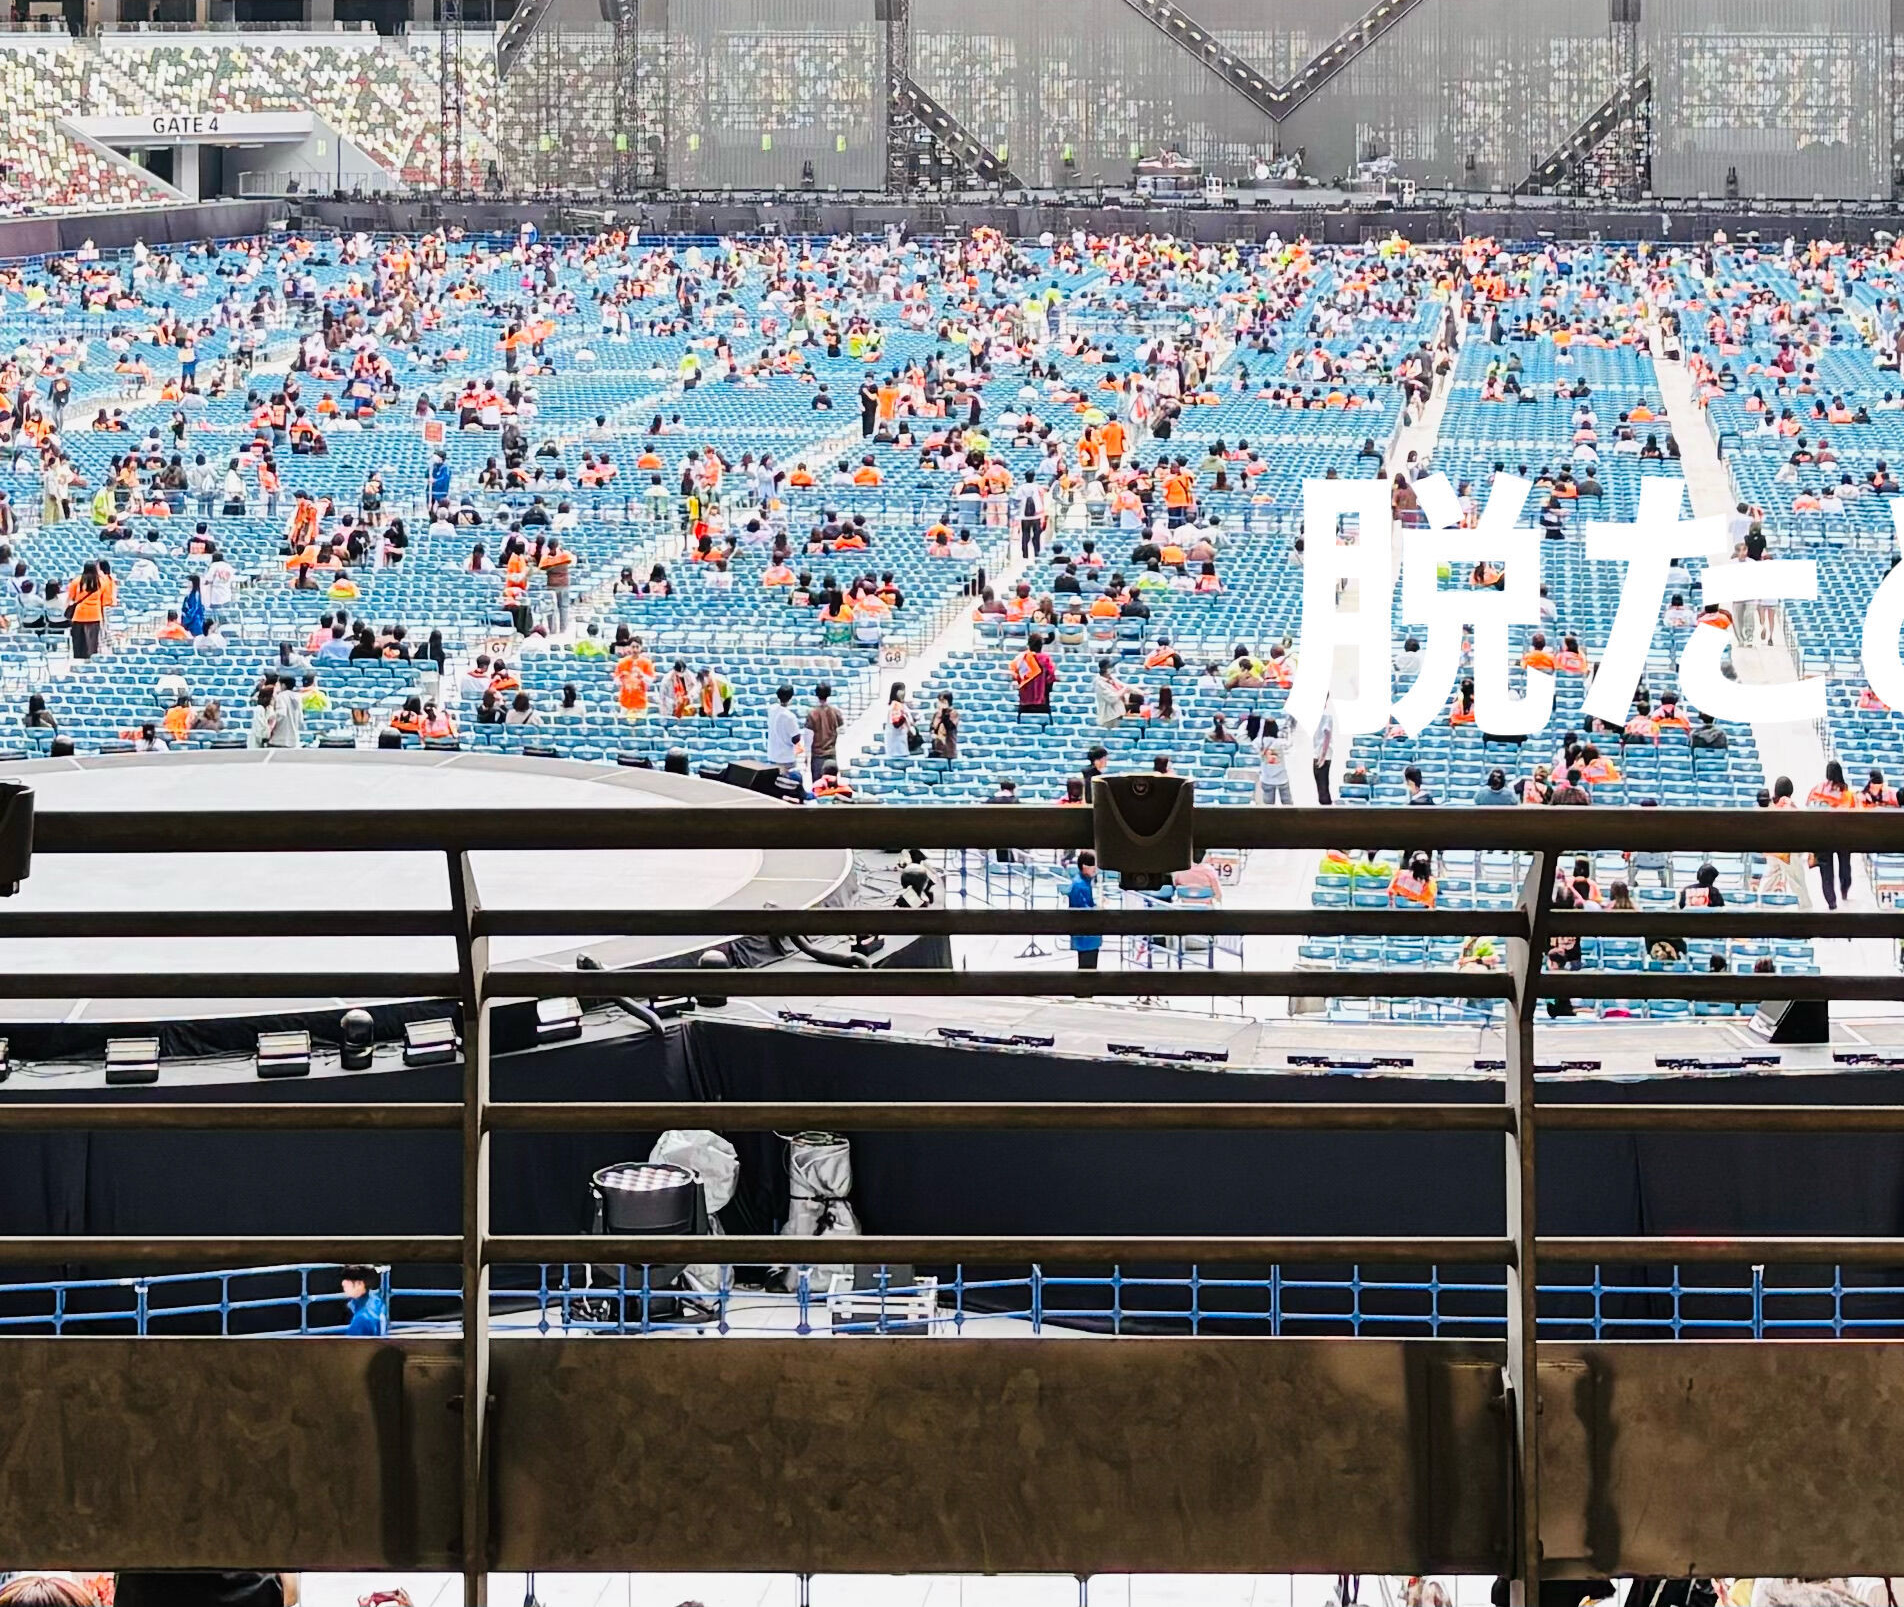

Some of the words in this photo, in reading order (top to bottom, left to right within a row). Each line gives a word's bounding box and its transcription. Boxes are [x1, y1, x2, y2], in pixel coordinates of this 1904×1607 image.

[153, 117, 203, 133] GATE
[209, 116, 219, 132] 4
[491, 642, 507, 654] G7
